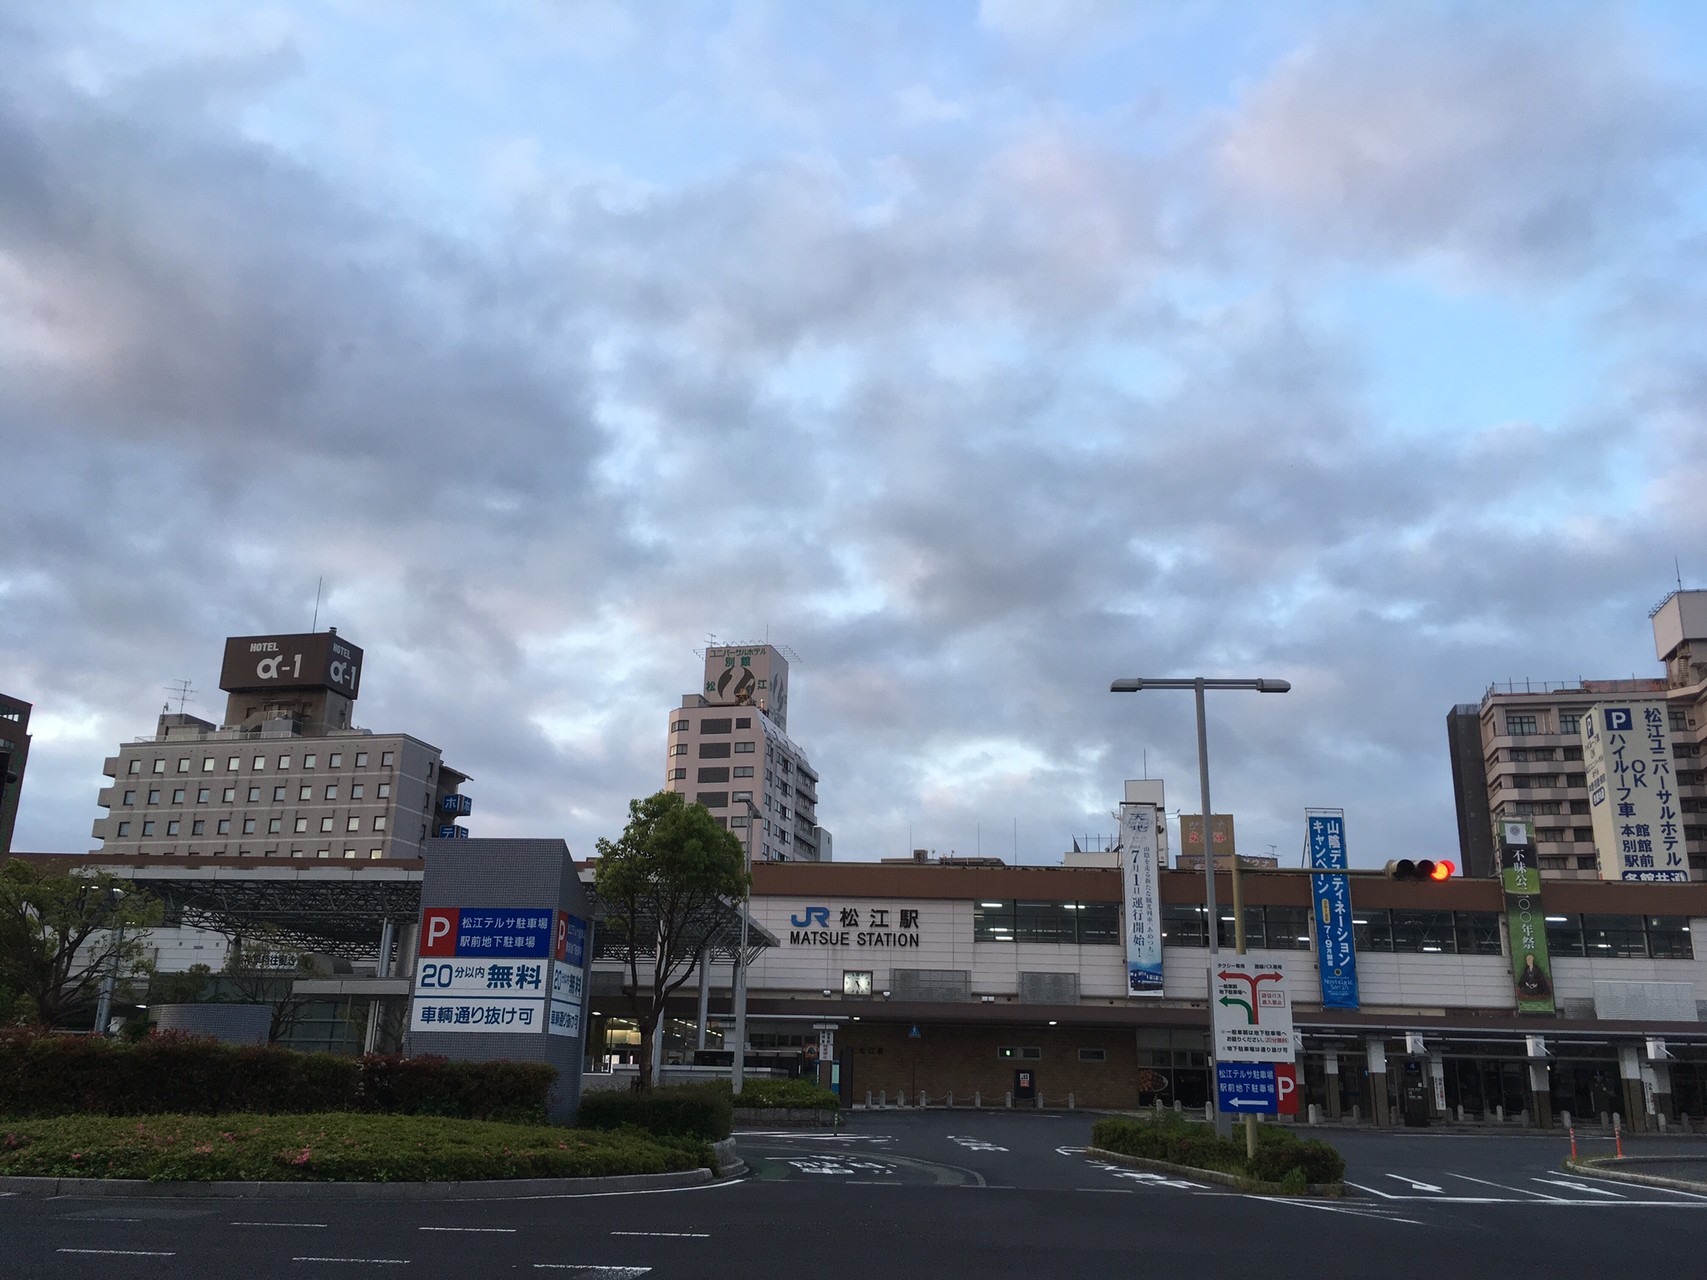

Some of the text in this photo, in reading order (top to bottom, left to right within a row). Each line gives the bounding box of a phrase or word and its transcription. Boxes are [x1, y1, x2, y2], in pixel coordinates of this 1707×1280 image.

[250, 642, 279, 652] HOTEL
[332, 642, 351, 660] HOTEL
[709, 648, 767, 658] ユニバーサルホテル
[256, 653, 303, 680] α-1
[725, 656, 751, 668] 別館
[329, 659, 357, 690] α-1
[706, 679, 767, 692] 松 江
[1611, 711, 1627, 729] P
[1609, 734, 1636, 818] ハイルーフ車
[1632, 759, 1648, 788] OK
[1644, 707, 1683, 867] 松江ユニバーサルホテル
[1620, 823, 1651, 838] 本館
[1622, 839, 1653, 854] 別館
[1624, 855, 1655, 869] 駅前
[462, 917, 549, 930] 松江テルサ駐車場
[791, 906, 830, 928] JR
[840, 907, 919, 929] 松江駅
[427, 916, 450, 947] P
[557, 919, 566, 950] P
[790, 931, 919, 947] MATSUE STATION
[459, 936, 536, 948] 駅前地下駐車場
[420, 964, 542, 990] 20分以内 無料
[1218, 1069, 1274, 1080] 松江テルサ駐車場
[1219, 1082, 1275, 1093] 駅前地下駐車場
[1277, 1076, 1295, 1101] P
